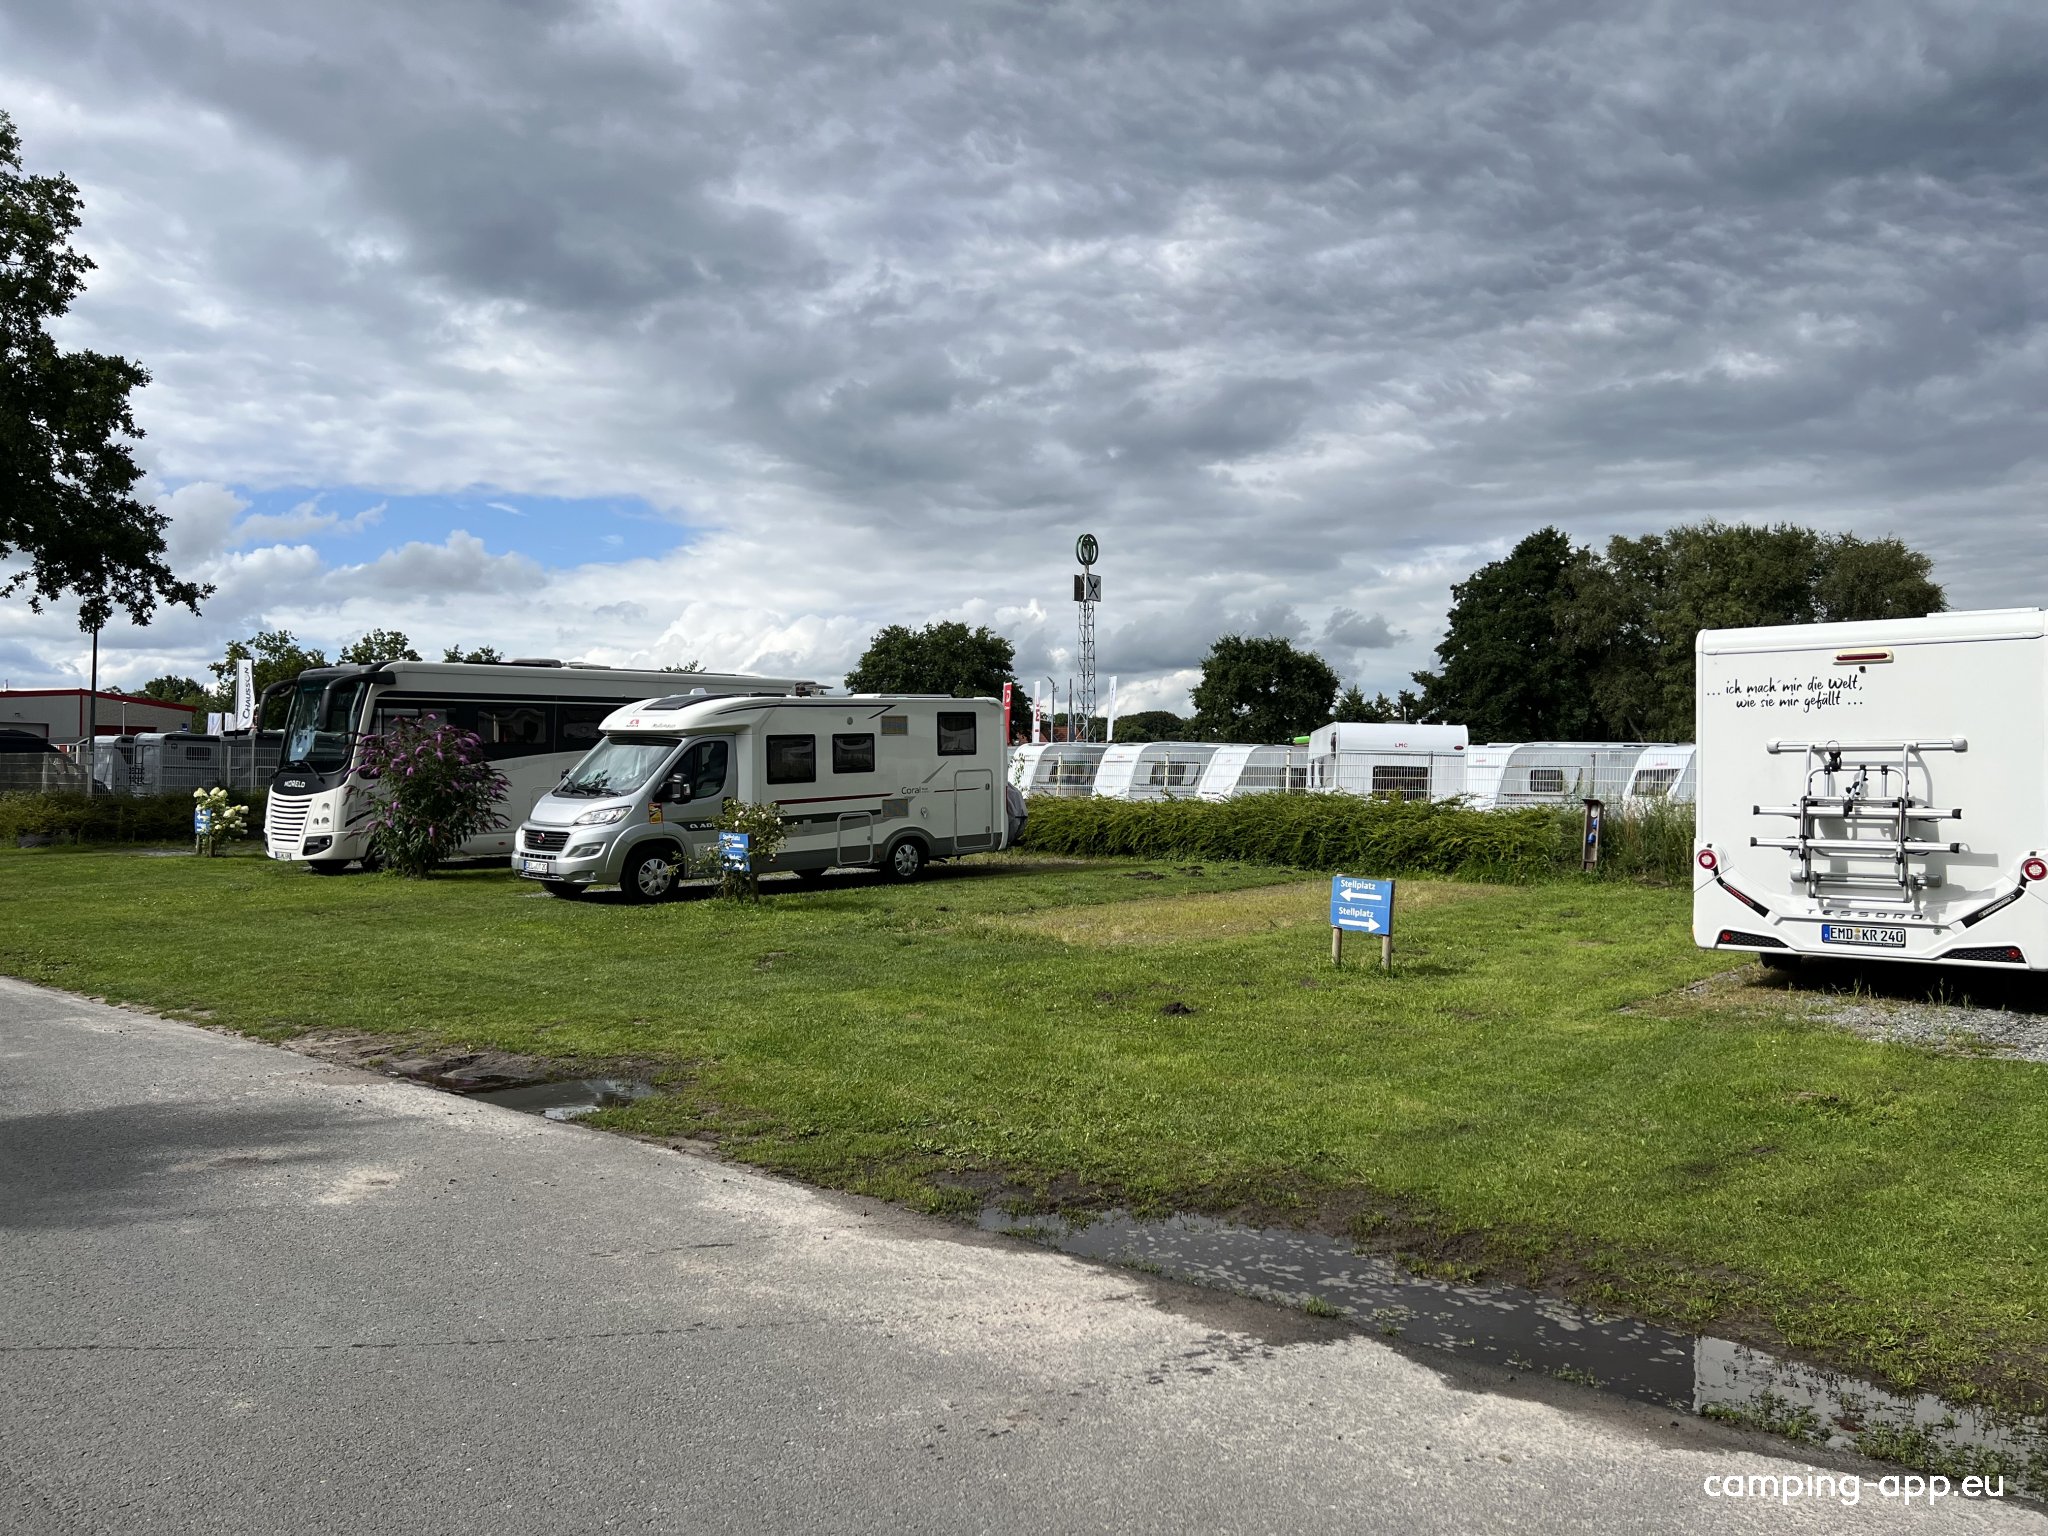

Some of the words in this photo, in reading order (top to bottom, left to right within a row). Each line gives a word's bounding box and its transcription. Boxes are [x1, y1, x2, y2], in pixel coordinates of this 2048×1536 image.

[1726, 678, 1742, 694] ich
[1782, 677, 1802, 692] mir
[1807, 676, 1823, 691] die
[1736, 694, 1756, 708] wie
[1760, 693, 1775, 708] sie
[1779, 692, 1799, 707] mir
[1803, 690, 1841, 713] gefällt
[284, 780, 305, 788] MORELO
[901, 786, 921, 795] Coral
[1340, 879, 1376, 890] Stellplatz
[1338, 906, 1374, 918] Stellplatz
[1830, 928, 1853, 940] EMD
[1862, 929, 1877, 942] KR
[1880, 931, 1904, 943] 240
